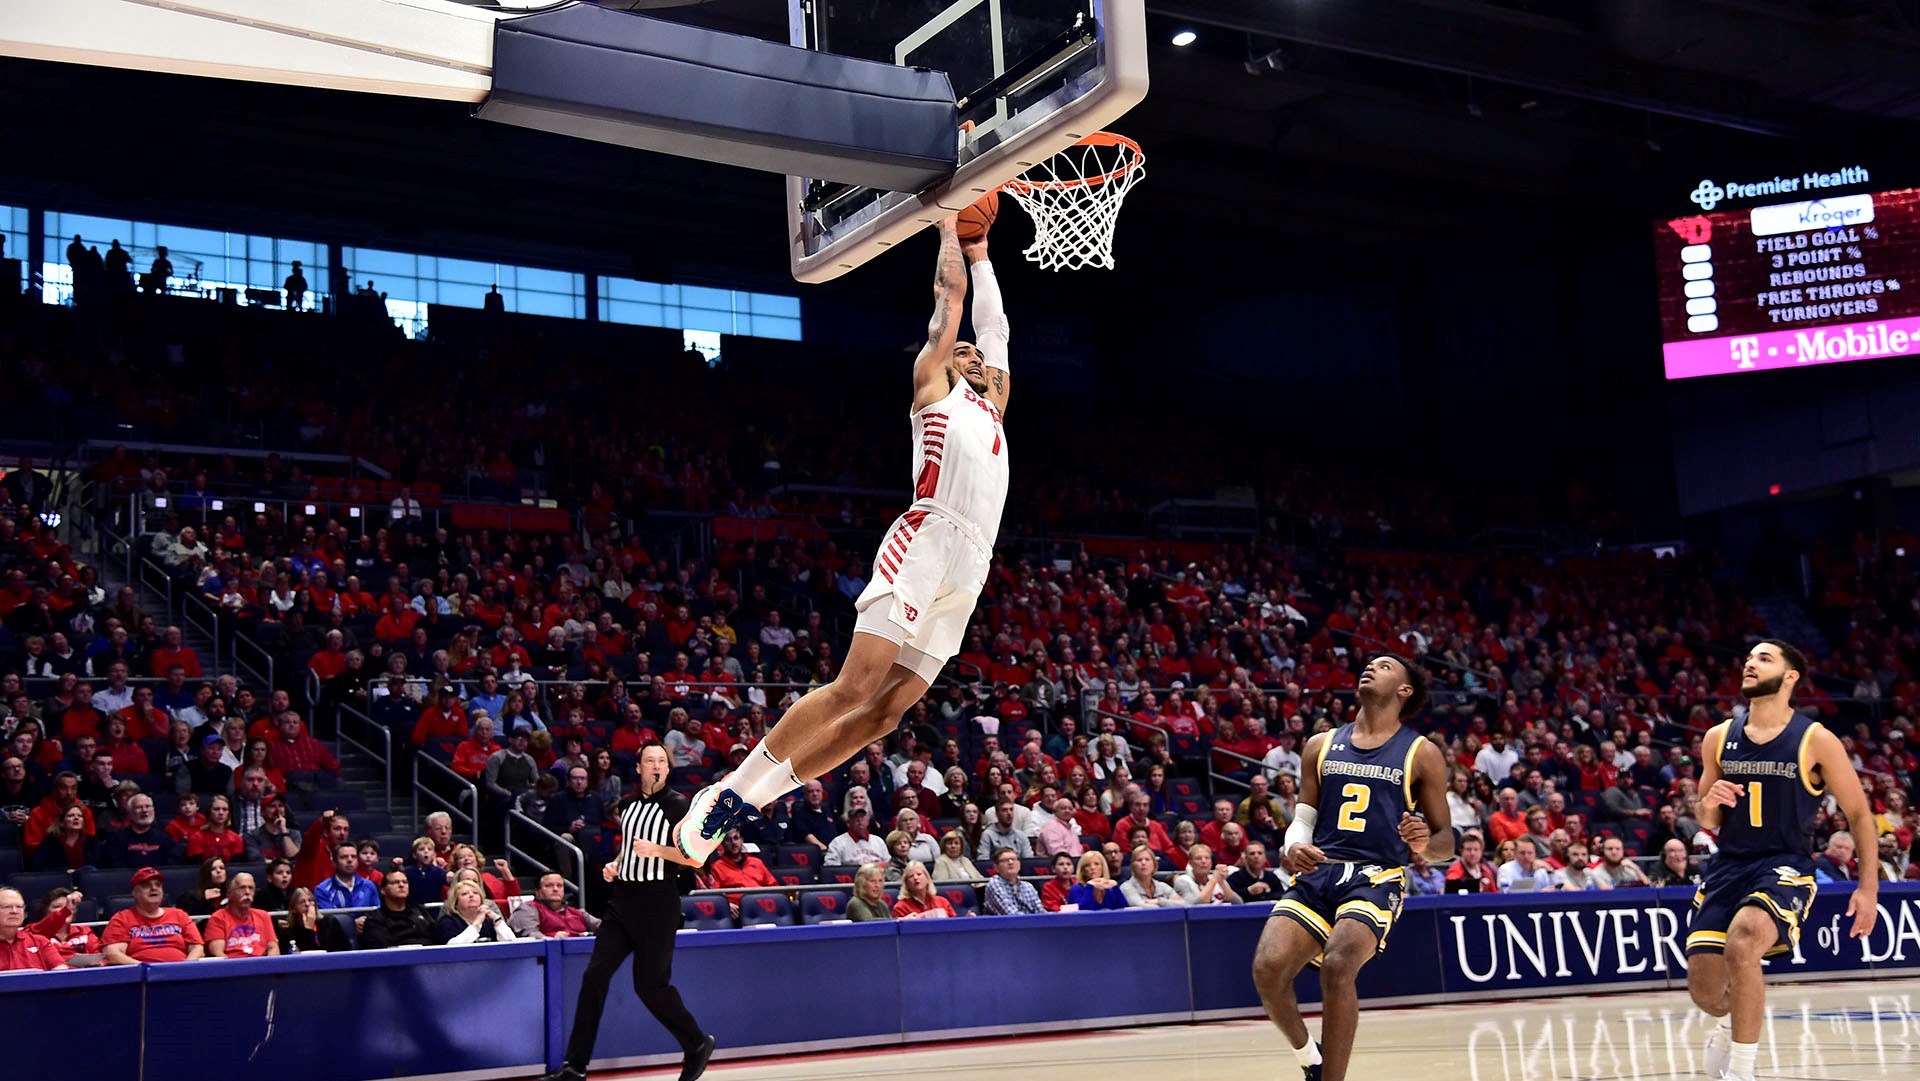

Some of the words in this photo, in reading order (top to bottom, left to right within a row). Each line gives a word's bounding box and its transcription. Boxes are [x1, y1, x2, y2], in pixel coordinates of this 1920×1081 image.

[1726, 176, 1801, 200] Premier
[1803, 166, 1869, 190] Health
[1799, 201, 1863, 231] Kroger
[1756, 235, 1808, 253] FIELD
[1811, 229, 1860, 248] GOAL
[1863, 226, 1879, 240] %
[1772, 254, 1784, 268] 3
[1788, 247, 1843, 266] POINT
[1846, 246, 1862, 259] %
[1769, 263, 1866, 286] REBOUNDS
[1757, 289, 1803, 307] FREE
[1806, 280, 1885, 301] THROWS
[1885, 278, 1901, 291] %
[1768, 298, 1878, 323] TURNOVERS
[1322, 760, 1404, 785] CEDARVILLE
[1337, 783, 1371, 832] 2
[1748, 782, 1764, 827] 1
[1450, 906, 1806, 983] UNIVER
[1817, 913, 1841, 956] of
[1860, 898, 1920, 963] DA
